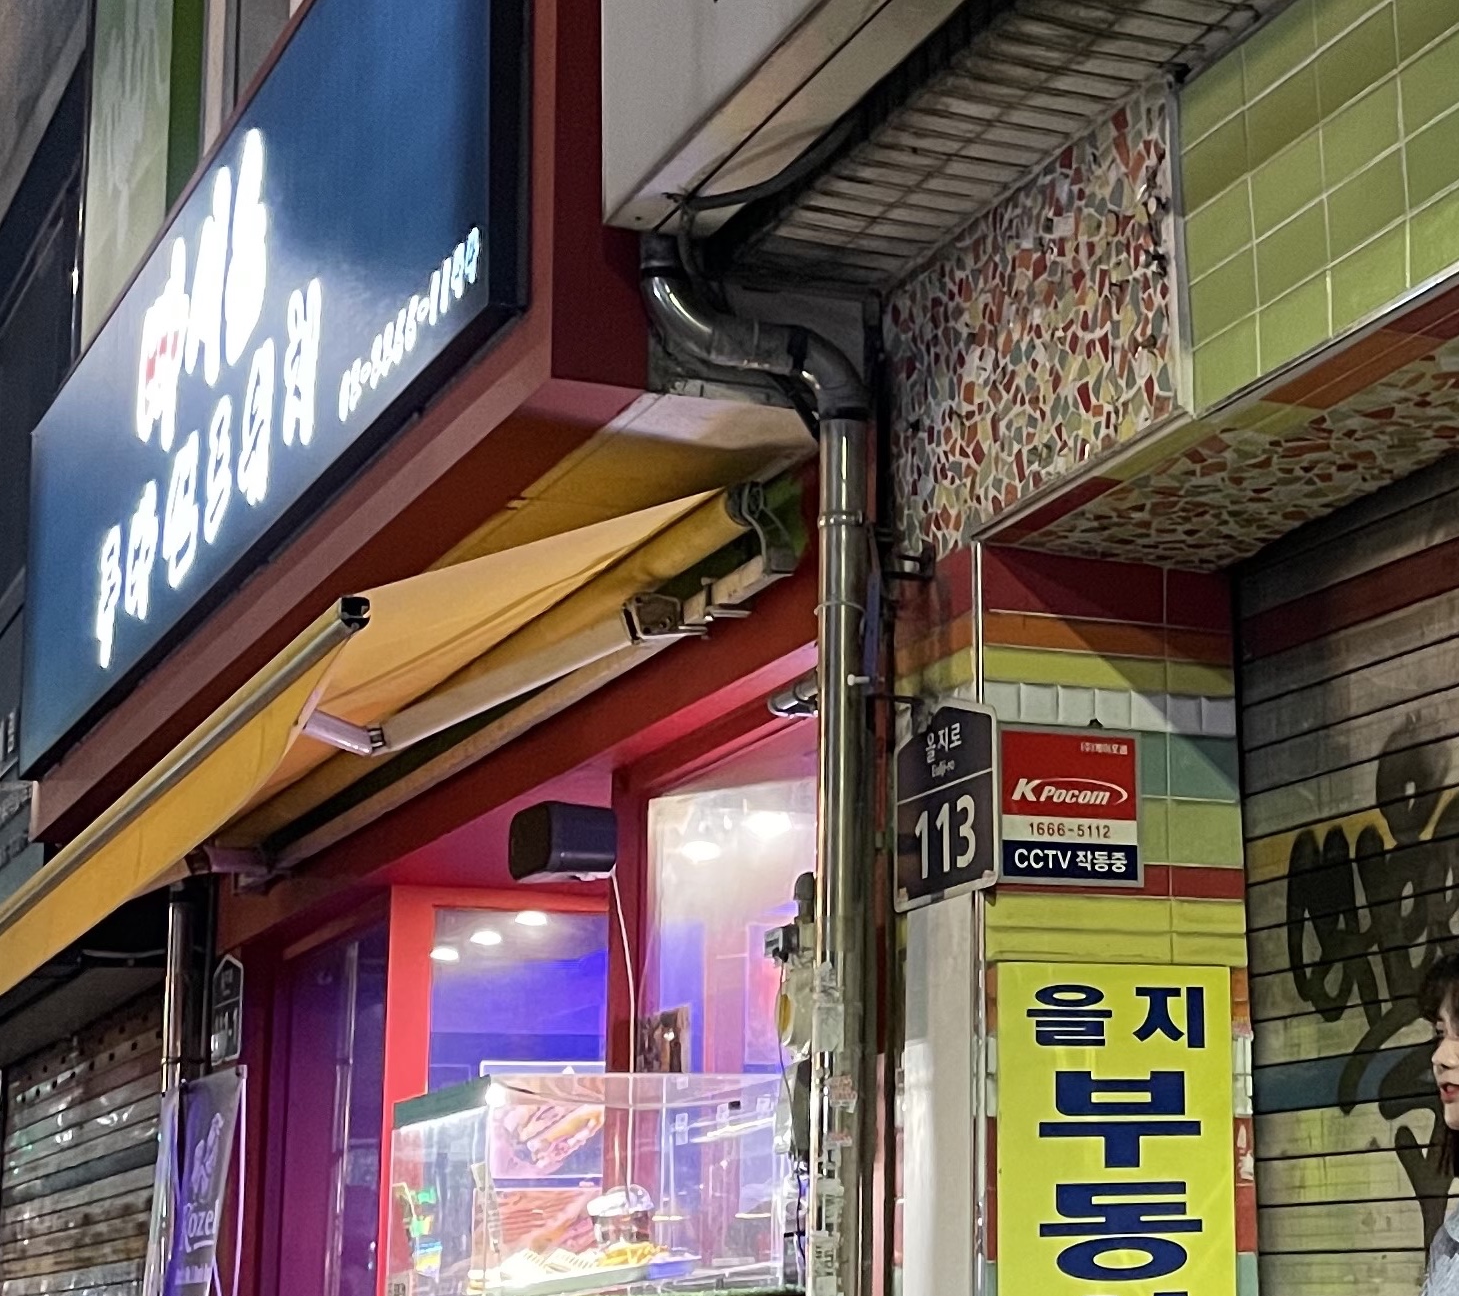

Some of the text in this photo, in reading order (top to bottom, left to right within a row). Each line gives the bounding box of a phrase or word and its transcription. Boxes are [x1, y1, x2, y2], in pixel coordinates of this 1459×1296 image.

[925, 722, 962, 764] 을지로
[914, 794, 977, 880] 113
[1028, 822, 1112, 839] 1666-5112
[1014, 848, 1128, 873] CCTV 작동중
[1026, 984, 1206, 1049] 을지
